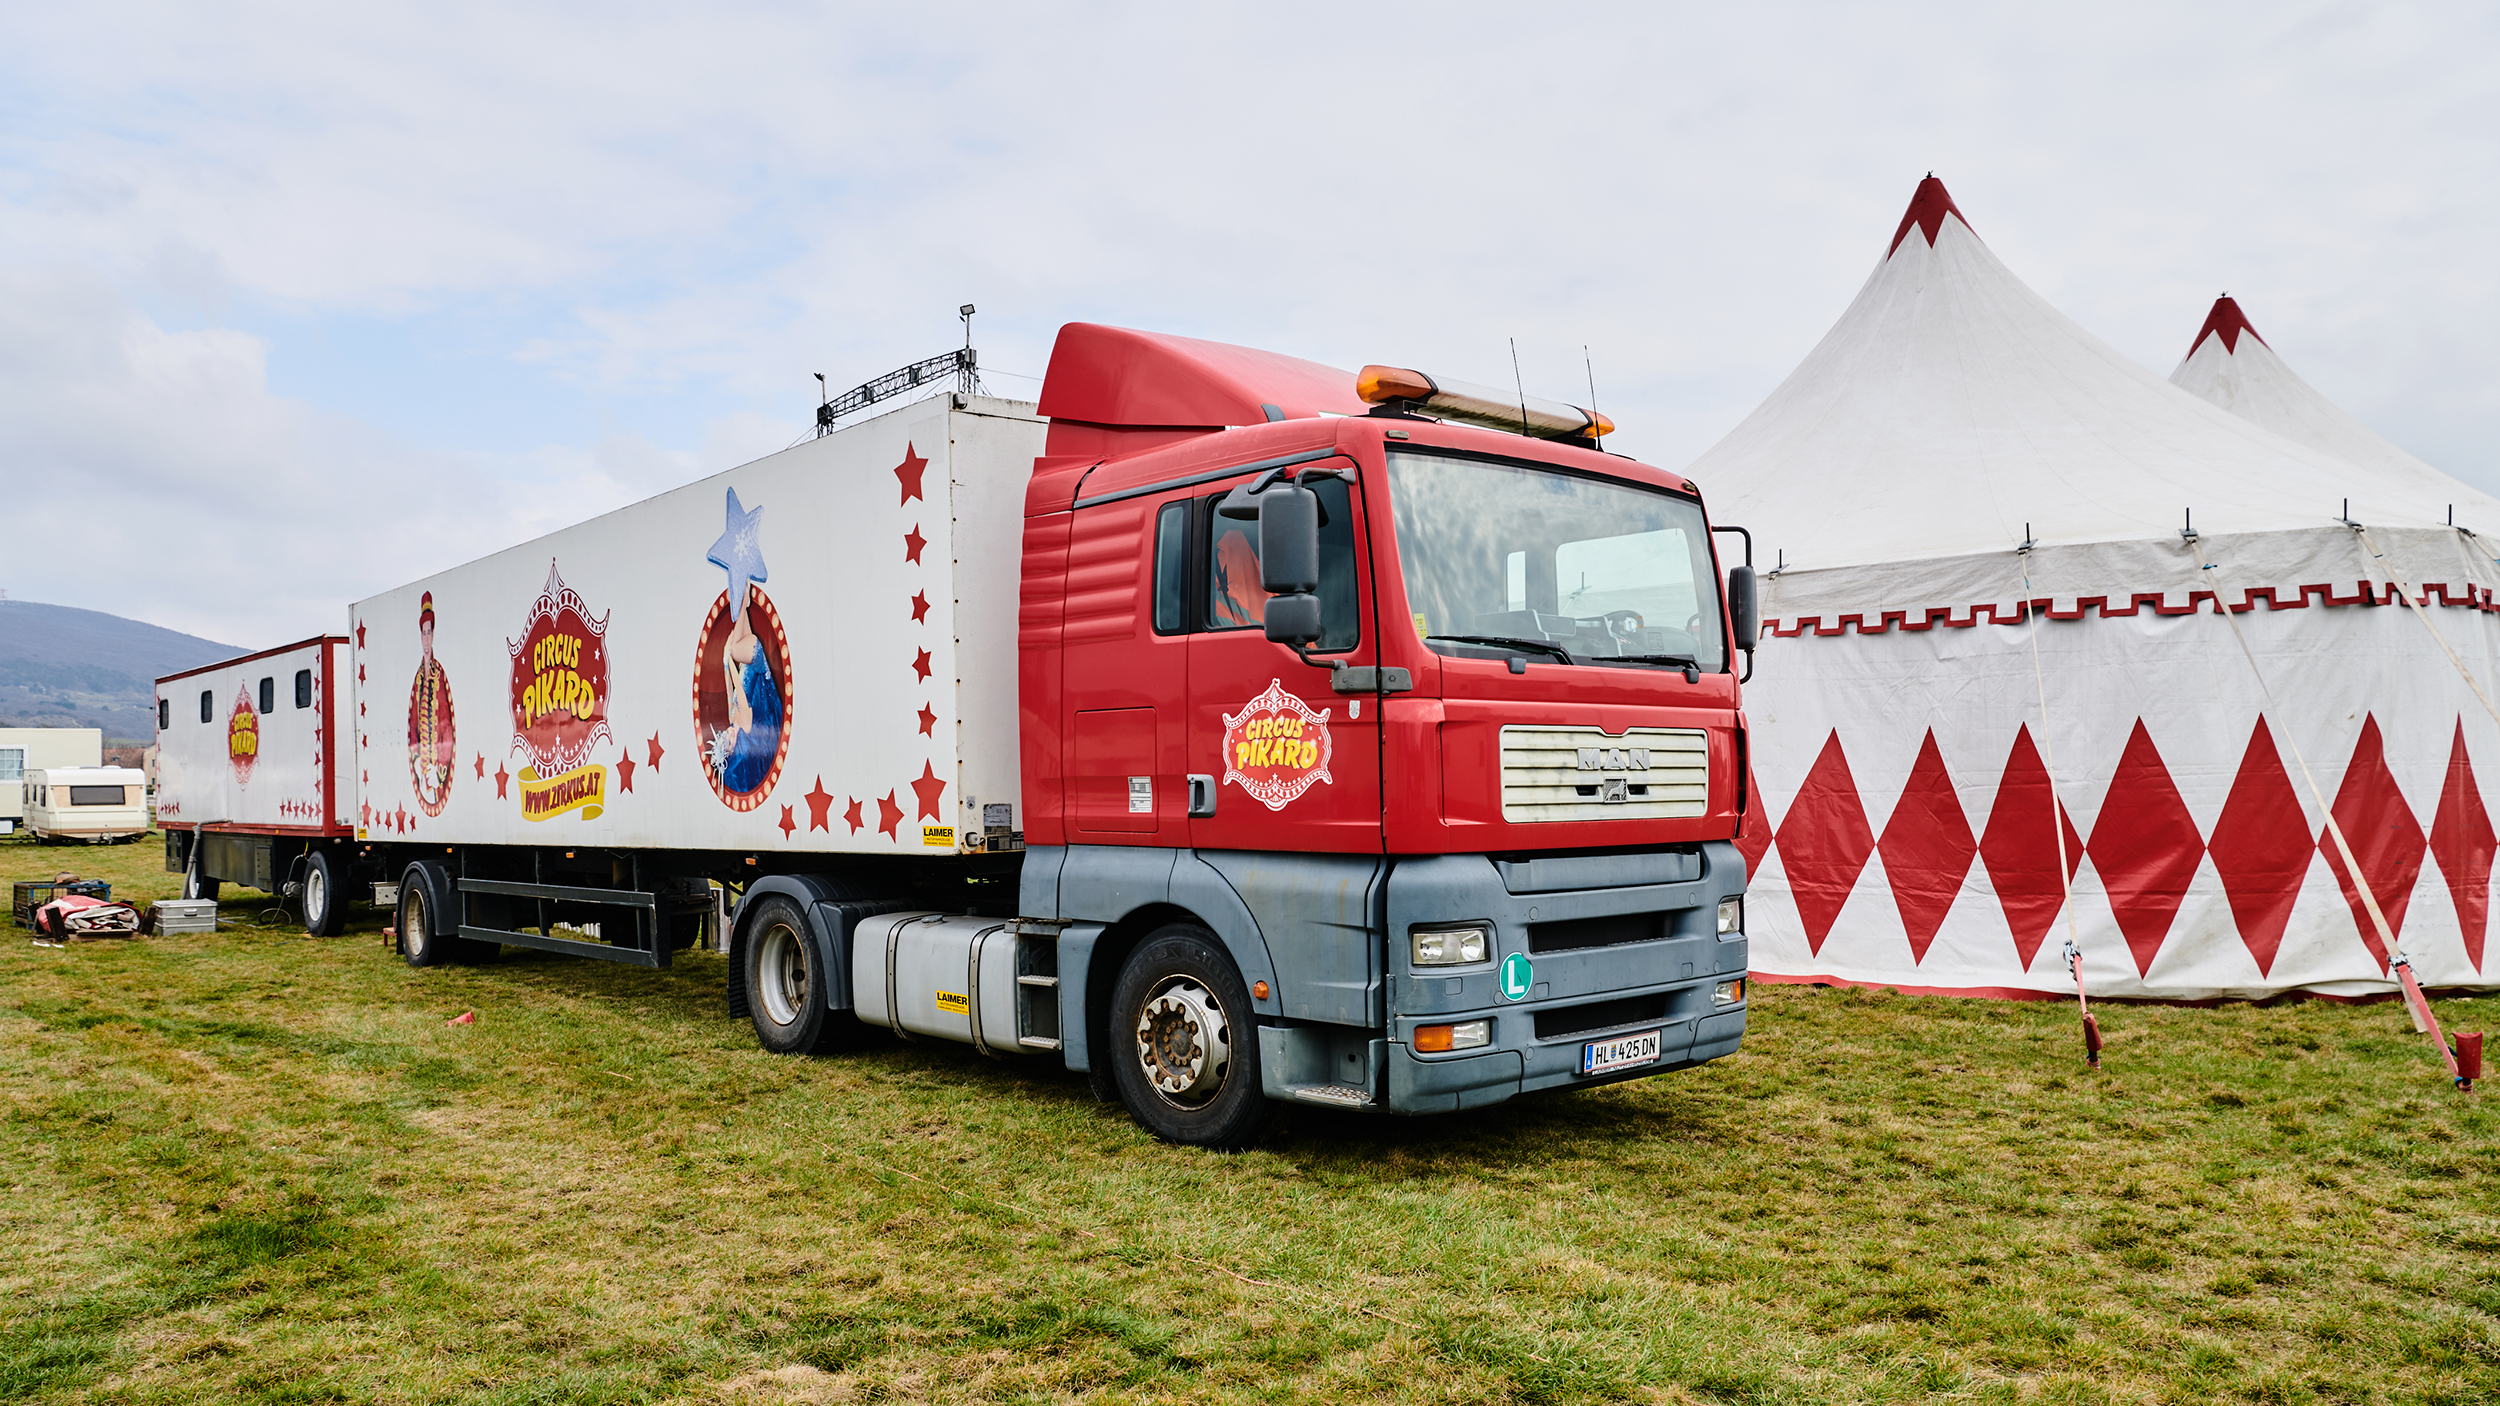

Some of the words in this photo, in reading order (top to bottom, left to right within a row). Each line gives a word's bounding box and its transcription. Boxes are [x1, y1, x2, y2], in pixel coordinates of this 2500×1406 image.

[534, 633, 582, 675] CIRCUS
[523, 669, 595, 730] PIKARD
[234, 711, 253, 732] CIRCUS
[1245, 717, 1306, 740] CIRCUS
[230, 730, 257, 758] PIKARD
[1236, 738, 1318, 770] PIKARD
[1578, 748, 1650, 769] MAN
[525, 772, 600, 814] WWW.ZIRKUS.AT
[923, 828, 953, 837] LAIMER
[1508, 960, 1524, 994] L
[937, 992, 968, 1005] LAIMER
[1595, 1046, 1609, 1065] HL
[1619, 1040, 1640, 1060] 425
[1642, 1036, 1656, 1056] DN
